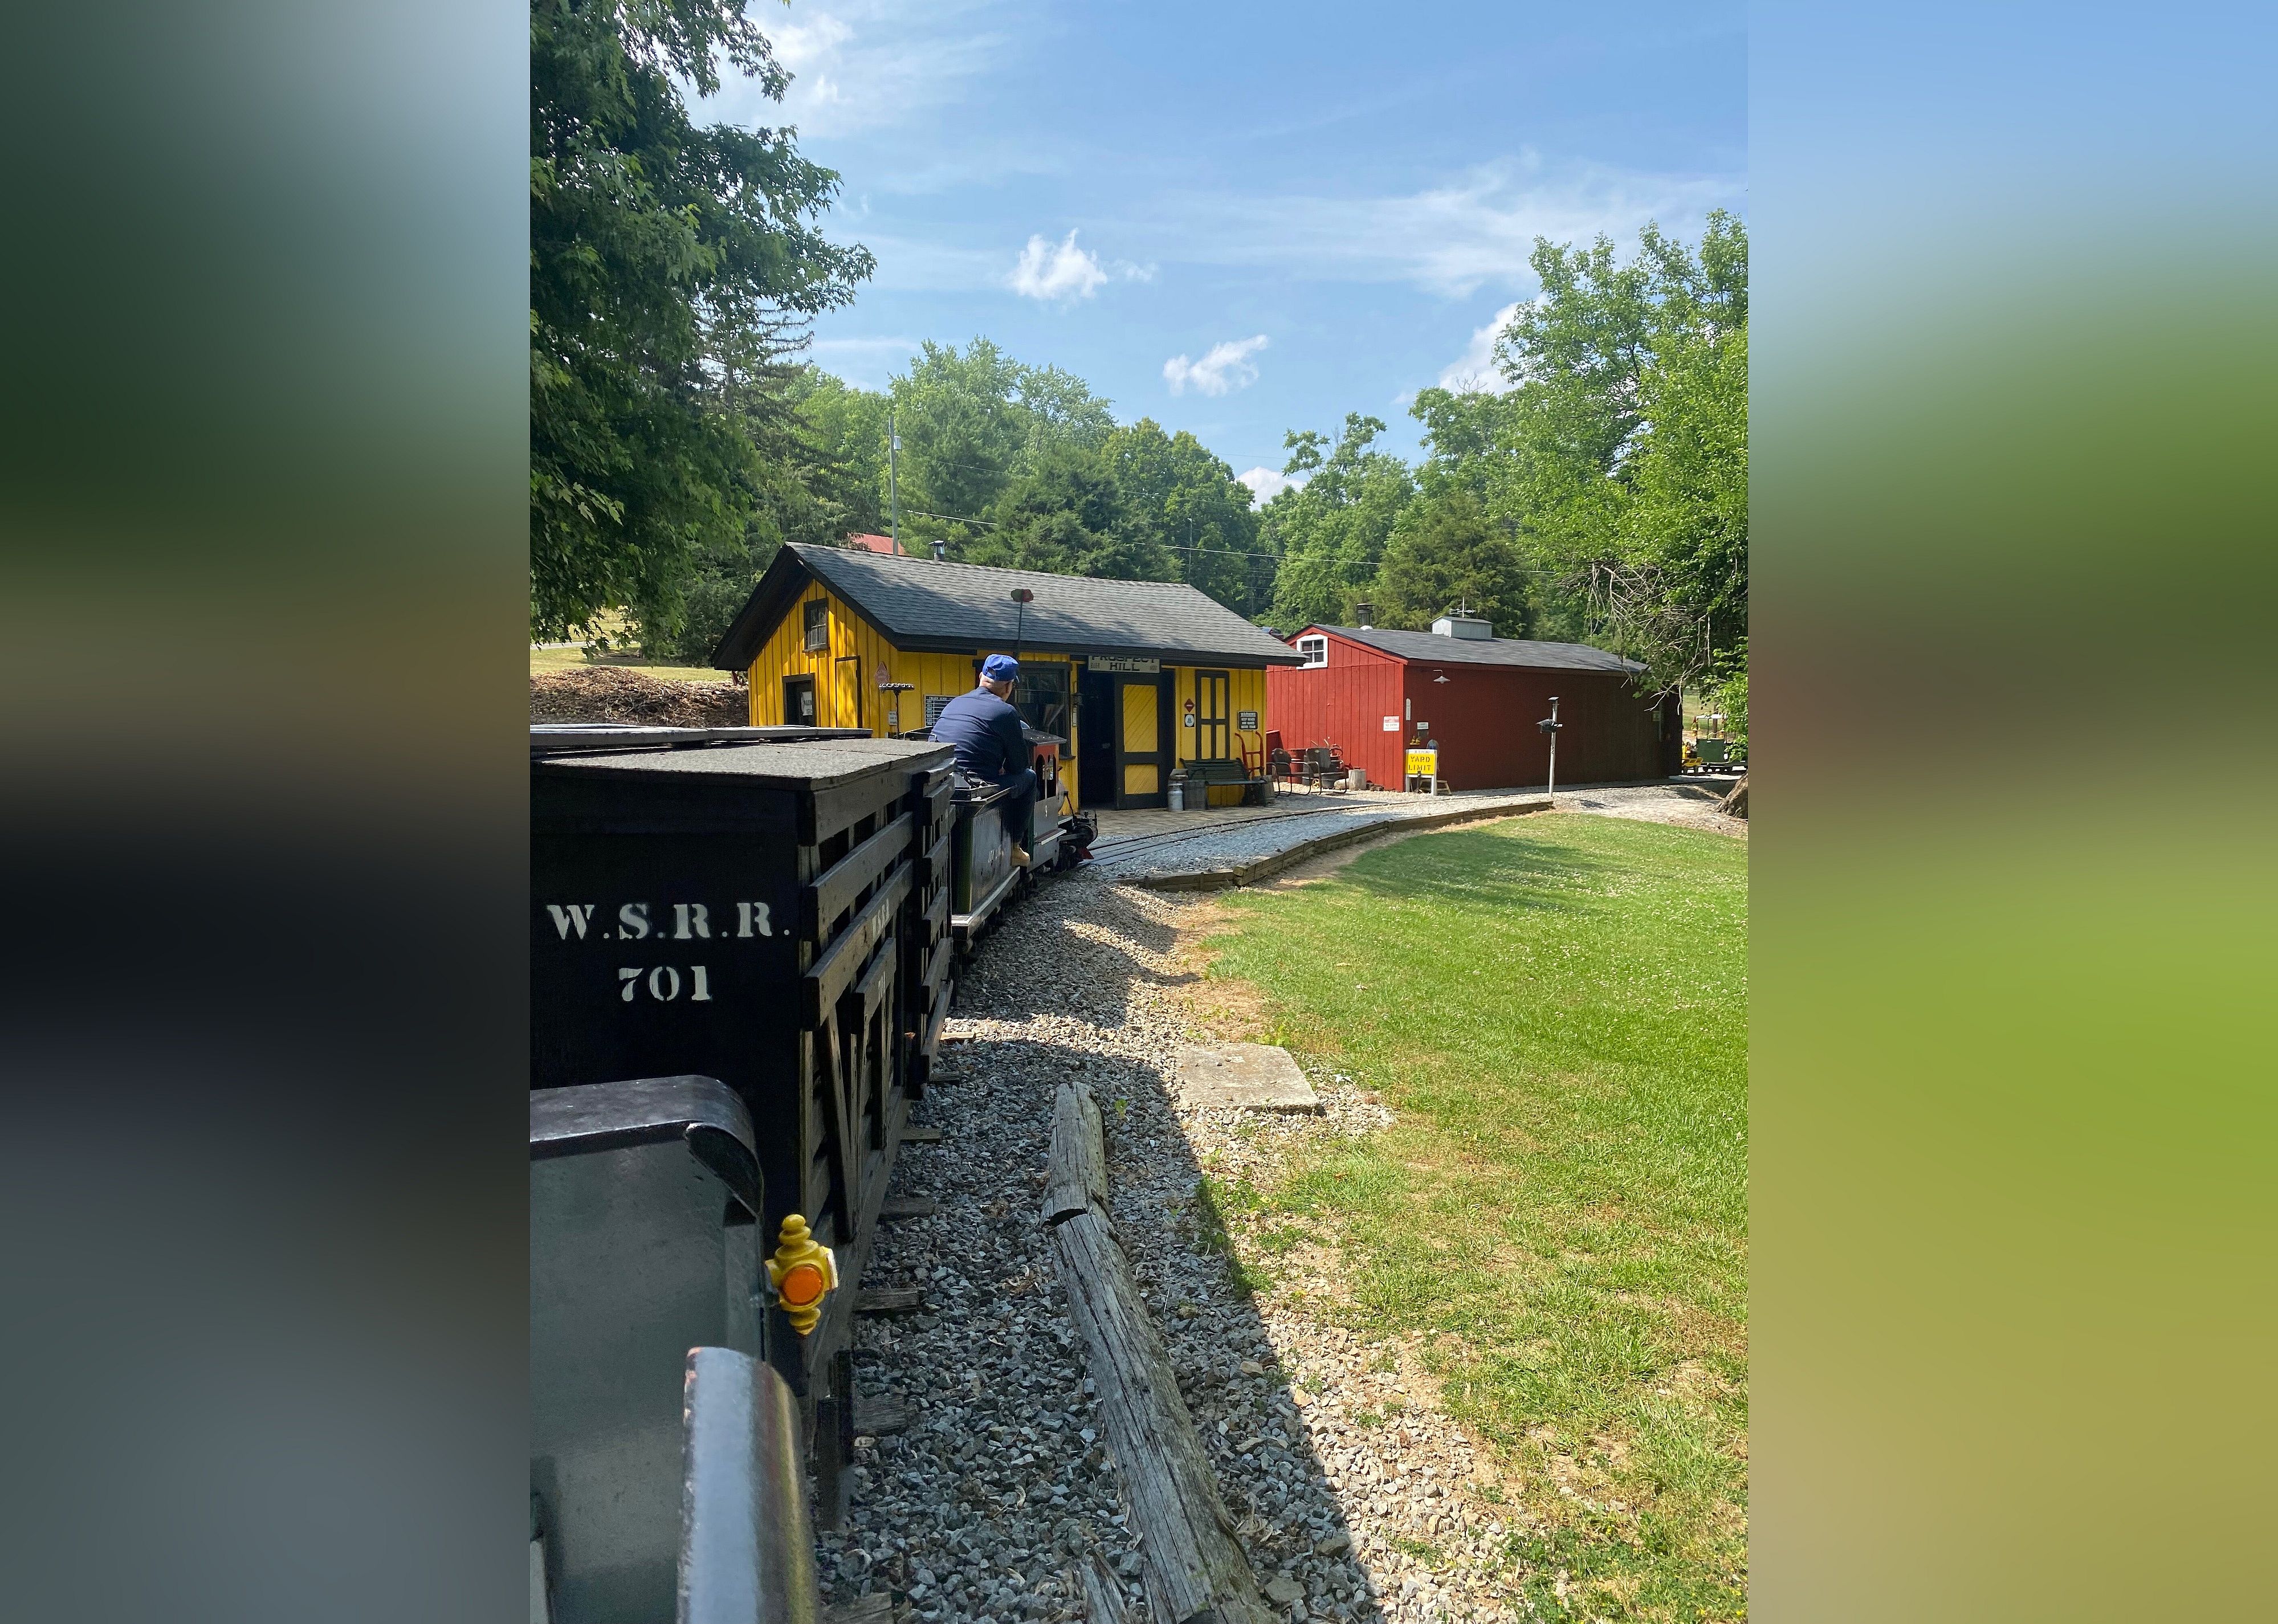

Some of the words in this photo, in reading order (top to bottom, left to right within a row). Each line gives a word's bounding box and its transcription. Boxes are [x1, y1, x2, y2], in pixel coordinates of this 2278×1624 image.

[1110, 662, 1140, 671] HILL
[547, 901, 790, 940] W.S.R.R.
[618, 965, 712, 1002] 701
